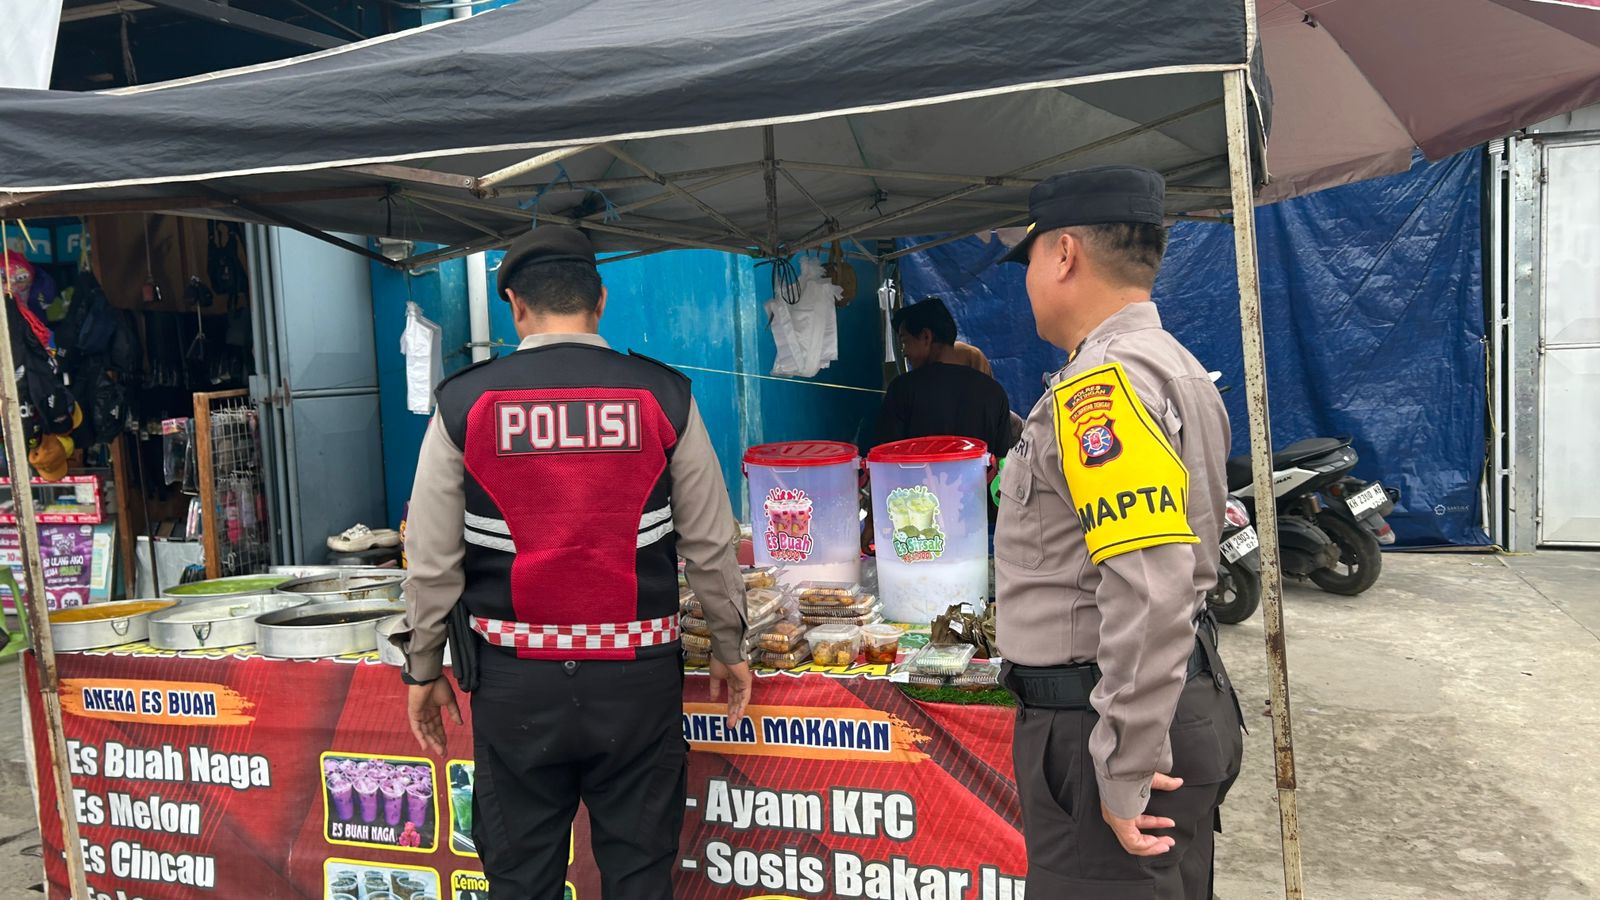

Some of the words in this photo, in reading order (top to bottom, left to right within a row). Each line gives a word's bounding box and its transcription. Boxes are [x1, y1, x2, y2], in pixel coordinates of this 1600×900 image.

[500, 404, 638, 450] POLISI
[765, 533, 778, 550] Es
[779, 533, 811, 552] Buah
[895, 541, 908, 556] Es
[1220, 541, 1234, 555] KH
[1233, 531, 1250, 546] 2903
[83, 688, 135, 713] ANEKA
[141, 690, 162, 714] ES
[169, 692, 216, 716] BUAH
[763, 716, 890, 751] MAKANAN
[66, 740, 98, 776] Es
[104, 742, 183, 782] Buah
[190, 747, 270, 789] Naga
[72, 789, 105, 825] Es
[108, 792, 200, 835] Melon
[705, 779, 822, 831] Ayam
[832, 789, 914, 839] KFC
[332, 822, 343, 838] ES
[345, 823, 369, 841] BUAH
[371, 825, 395, 843] NAGA
[80, 839, 106, 874] Es
[111, 841, 216, 888] Cincau
[706, 841, 825, 893] Sosis
[834, 852, 968, 900] Bakar
